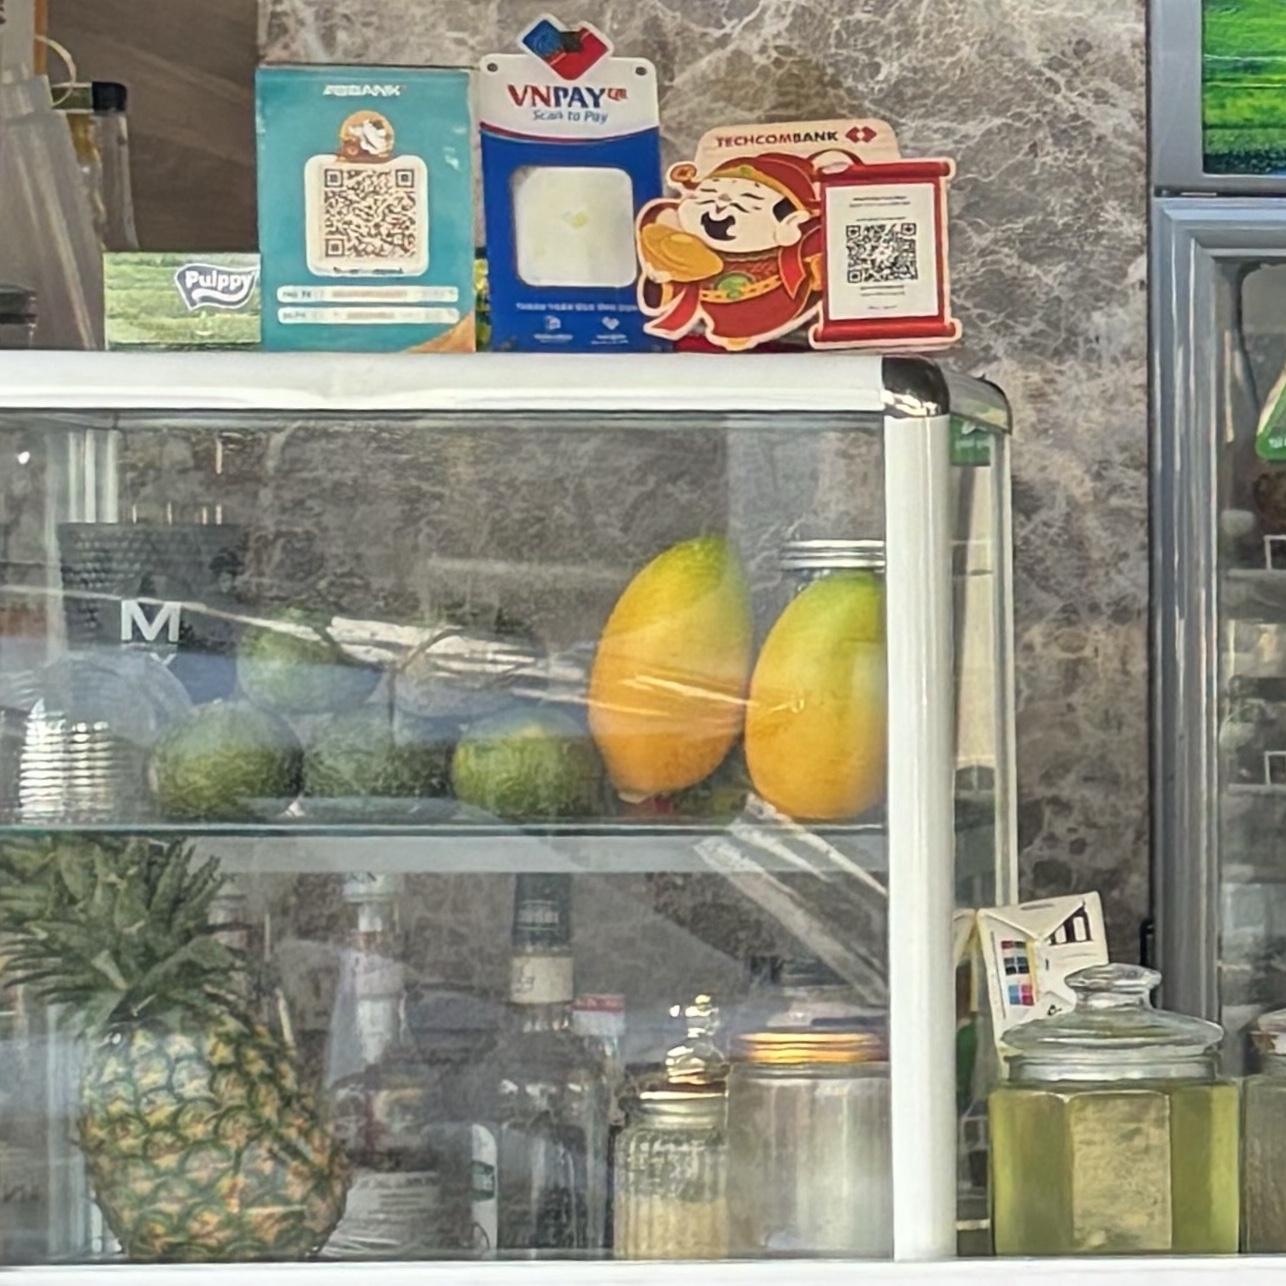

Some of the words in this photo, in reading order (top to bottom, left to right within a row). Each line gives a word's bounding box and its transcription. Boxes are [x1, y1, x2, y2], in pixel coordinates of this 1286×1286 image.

[533, 109, 564, 122] Scan
[567, 111, 582, 122] to
[584, 110, 609, 125] Pay
[714, 130, 839, 148] TECHCOMBANK
[184, 268, 256, 298] Pulppy
